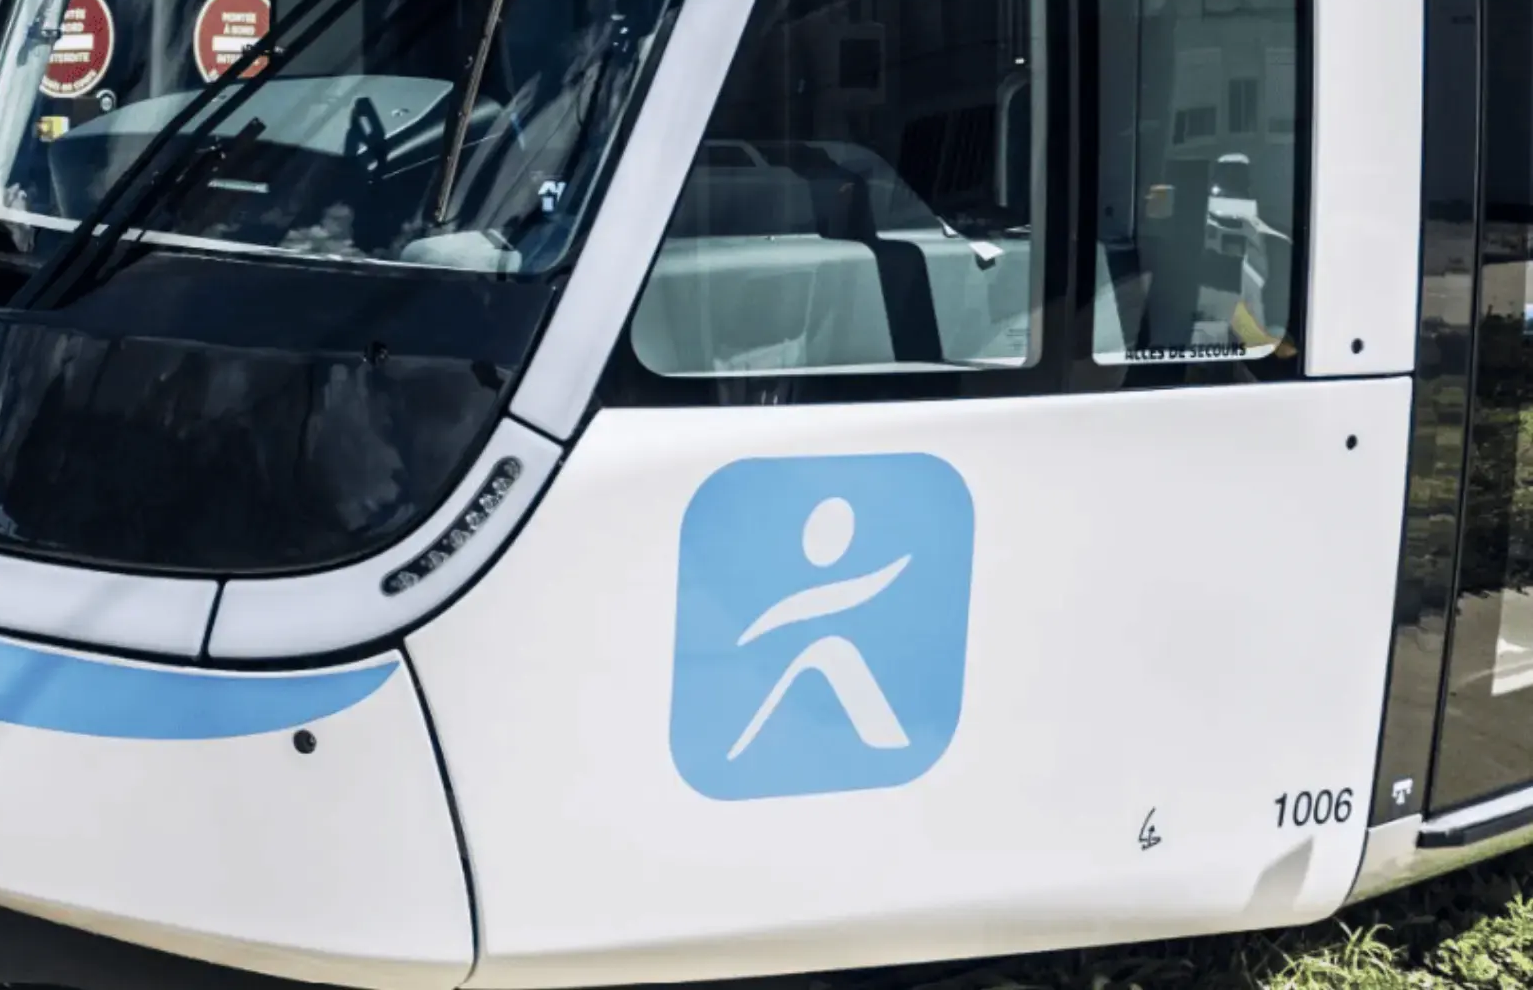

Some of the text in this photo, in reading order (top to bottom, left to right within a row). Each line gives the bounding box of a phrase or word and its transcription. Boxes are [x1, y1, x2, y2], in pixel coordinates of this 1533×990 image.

[1168, 343, 1187, 359] DE
[1189, 342, 1247, 358] SECOURS
[1273, 787, 1354, 828] 1006
